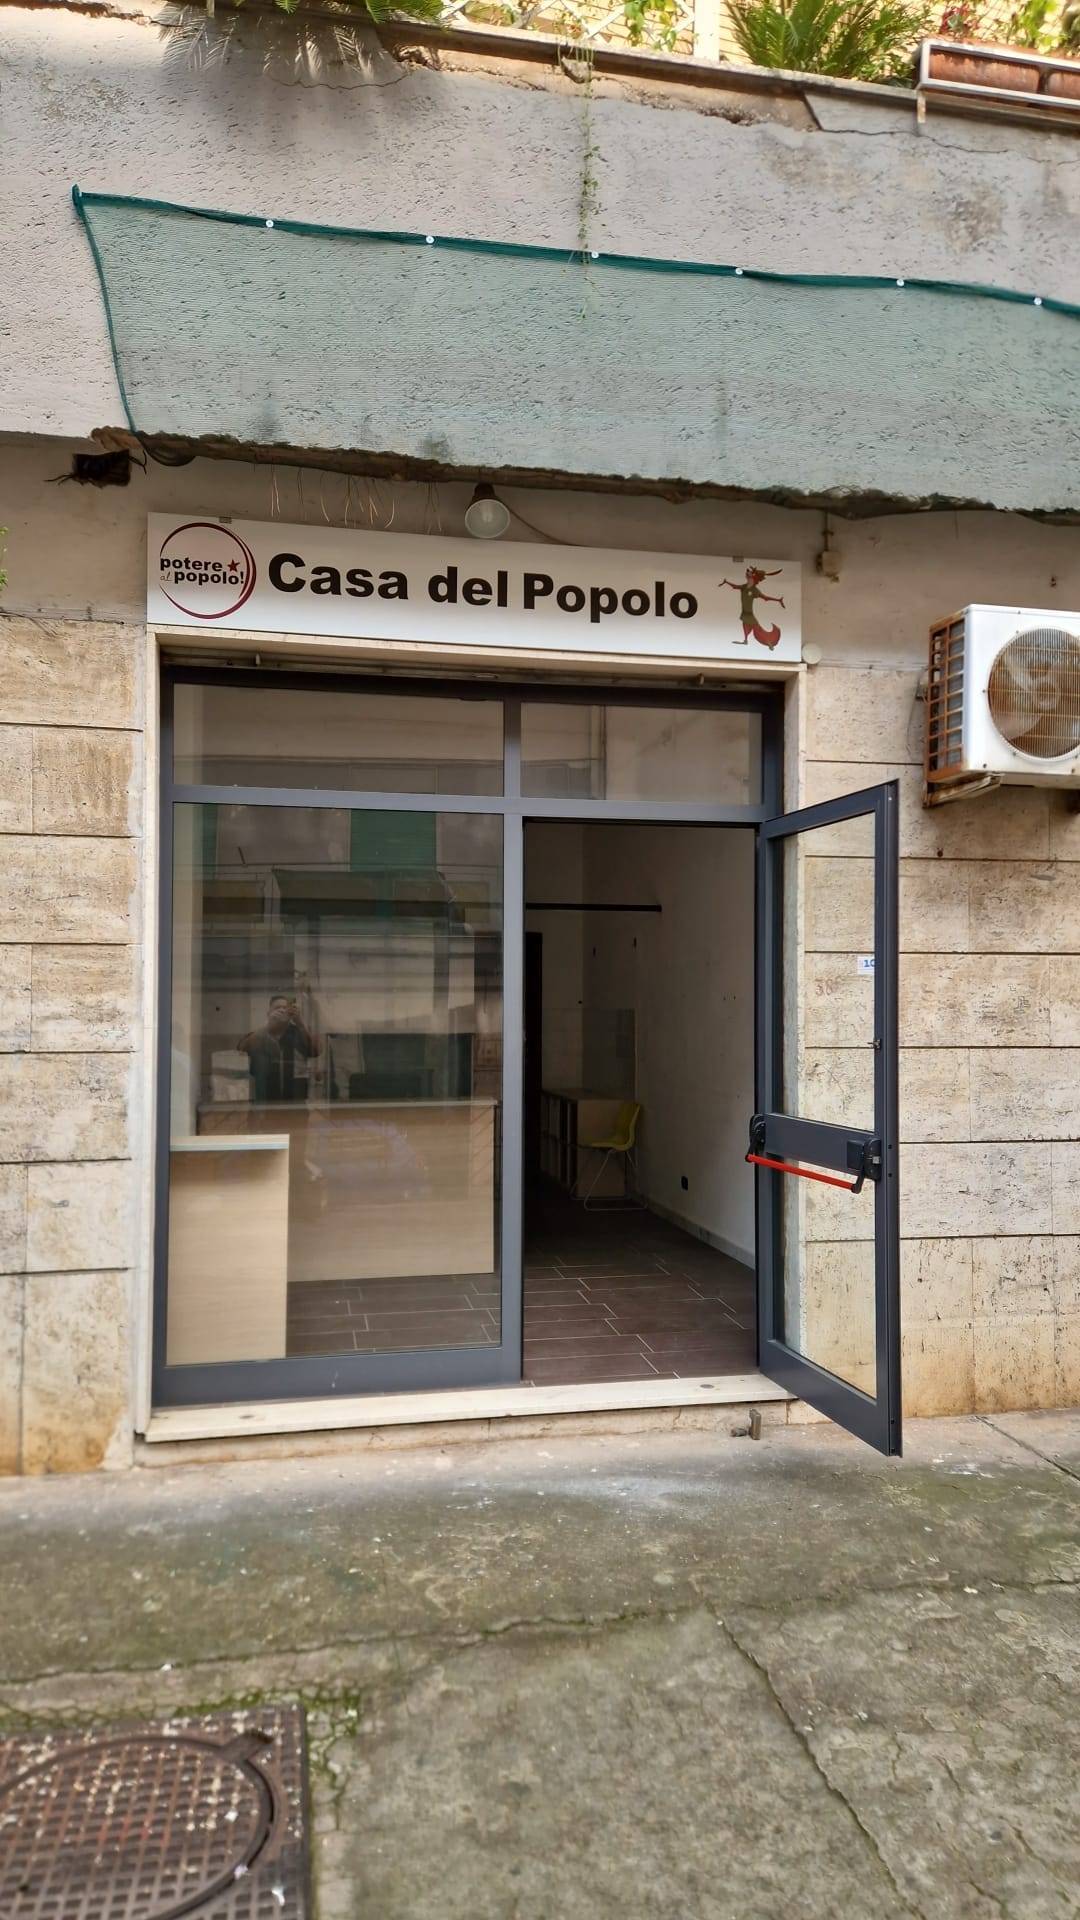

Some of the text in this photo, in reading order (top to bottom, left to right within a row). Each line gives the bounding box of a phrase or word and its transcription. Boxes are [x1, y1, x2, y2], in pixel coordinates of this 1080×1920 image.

[160, 557, 223, 571] potere
[174, 571, 244, 585] popolo!
[268, 552, 698, 623] Casa del Popolo
